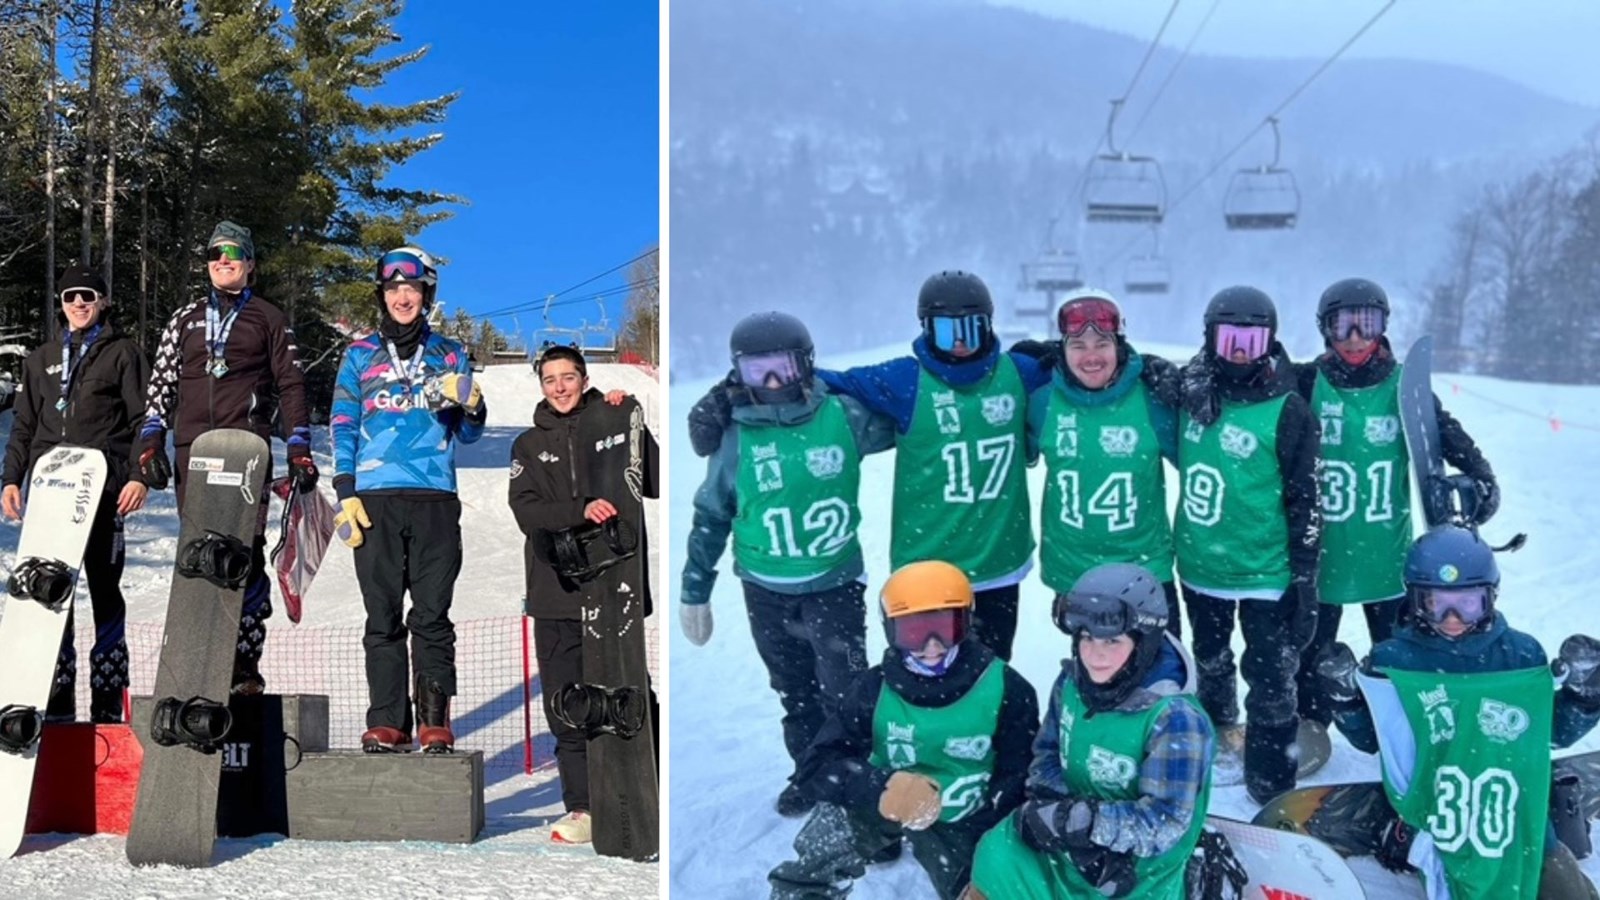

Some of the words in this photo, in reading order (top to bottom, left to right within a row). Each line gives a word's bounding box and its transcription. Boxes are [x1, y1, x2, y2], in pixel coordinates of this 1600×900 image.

[941, 432, 1015, 503] 17
[1184, 462, 1226, 527] 9
[1318, 460, 1393, 521] 31
[762, 497, 854, 556] 12
[1057, 469, 1138, 531] 14
[1477, 697, 1530, 737] 50
[1427, 765, 1519, 857] 30
